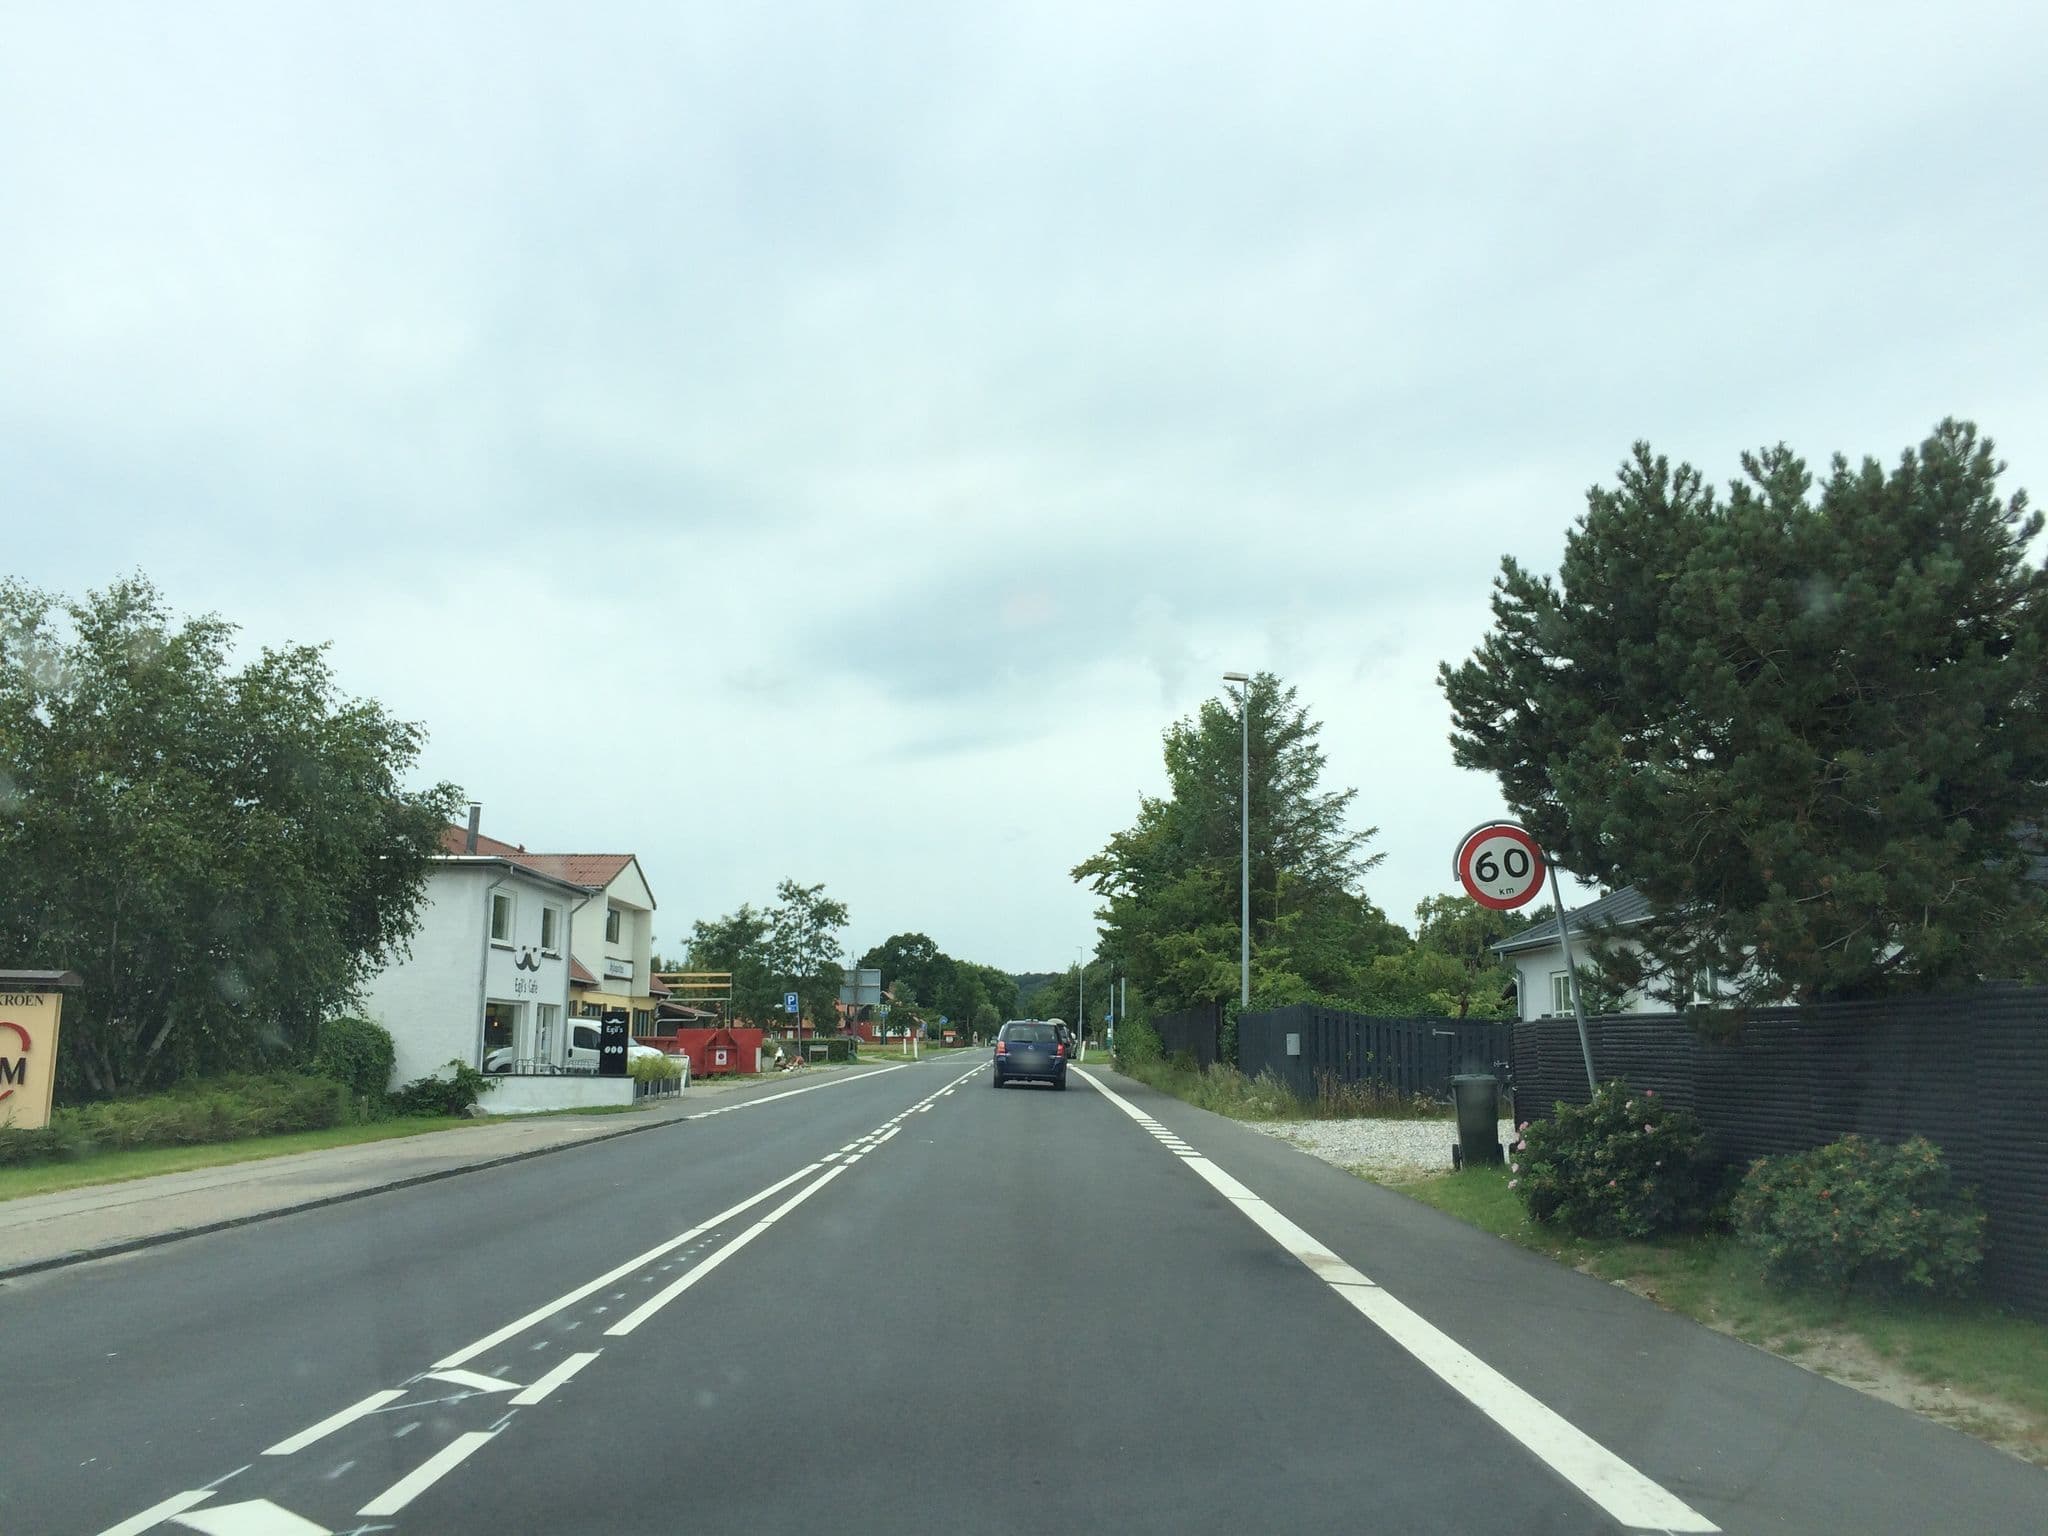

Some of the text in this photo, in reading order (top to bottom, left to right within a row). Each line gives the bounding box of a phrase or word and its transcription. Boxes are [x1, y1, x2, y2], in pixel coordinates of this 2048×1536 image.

[1476, 848, 1529, 883] 60
[1499, 887, 1515, 896] km
[787, 995, 795, 1005] P
[606, 1025, 624, 1035] Egil's
